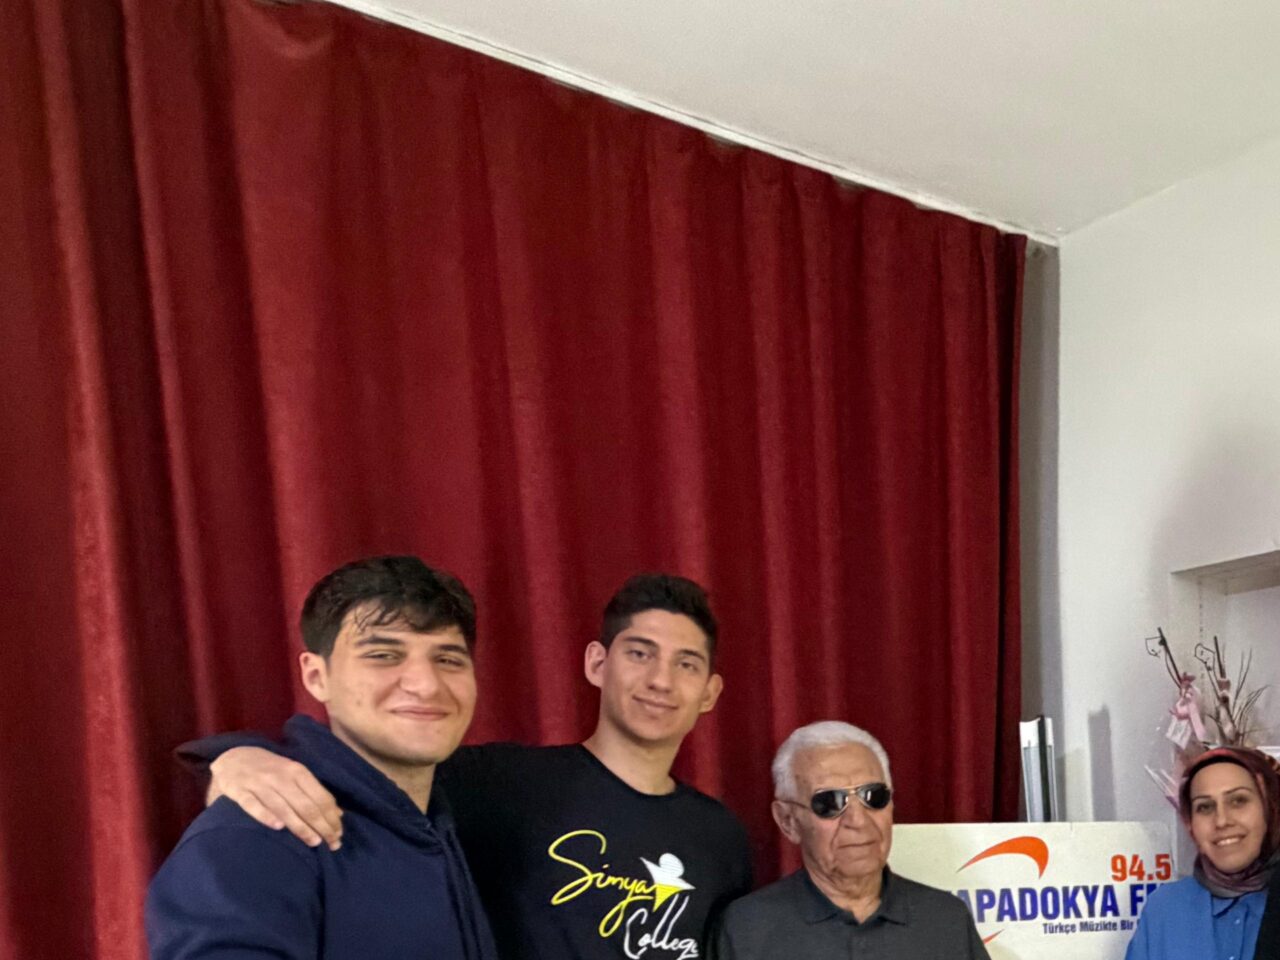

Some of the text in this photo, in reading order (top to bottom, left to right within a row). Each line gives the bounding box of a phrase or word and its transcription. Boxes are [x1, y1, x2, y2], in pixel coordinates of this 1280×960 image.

[548, 829, 657, 938] Simya
[1111, 854, 1172, 882] 94.5
[952, 883, 1157, 923] APADOKYA F
[1043, 922, 1076, 934] Türkçe
[1080, 920, 1117, 932] Müzikte
[1120, 919, 1134, 931] Bir
